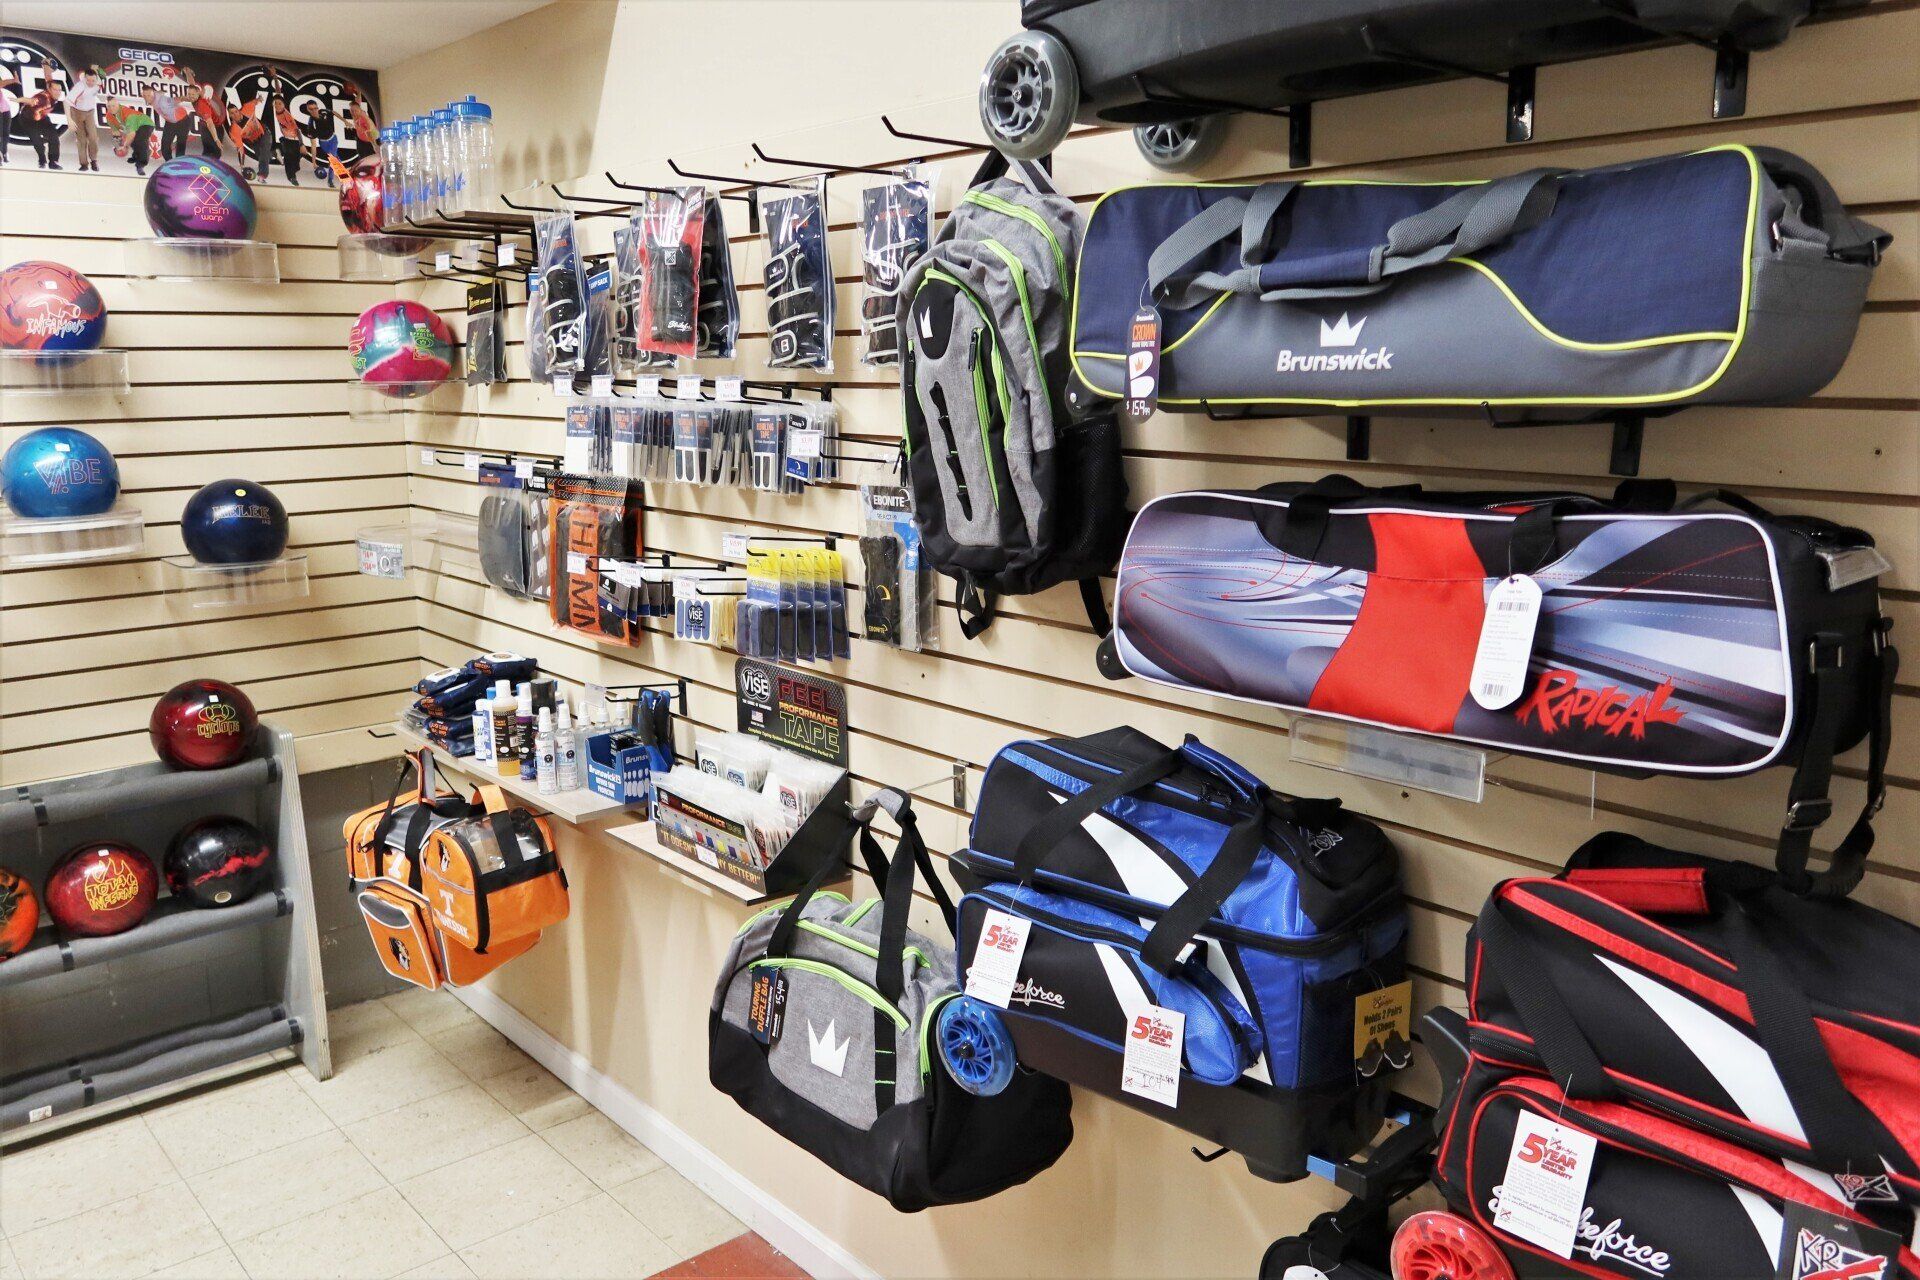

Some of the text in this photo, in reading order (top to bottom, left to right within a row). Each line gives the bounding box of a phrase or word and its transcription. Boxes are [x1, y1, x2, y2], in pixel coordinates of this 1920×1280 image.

[120, 49, 174, 64] GEICO
[121, 63, 162, 79] PBA
[194, 204, 229, 216] prism
[201, 214, 223, 222] warp
[26, 317, 86, 337] INFAMOUS
[1132, 323, 1157, 341] CROWN
[1276, 347, 1395, 372] Brunswick
[873, 494, 904, 508] EBONITE
[776, 675, 839, 716] FEEL
[1515, 669, 1687, 742] RADICAL
[778, 701, 838, 727] PROFORMANCE
[196, 719, 241, 739] cyclops
[780, 710, 839, 754] TAPE
[86, 873, 138, 899] TOTAL
[983, 925, 1002, 947] 5
[999, 933, 1018, 946] YEAR
[751, 982, 761, 1021] TOURING
[756, 976, 769, 1033] DUFFLE BAG
[1363, 1005, 1402, 1026] Holds 2 Pairs
[1131, 1015, 1151, 1040] 5
[1149, 1026, 1174, 1040] YEAR
[1377, 1020, 1396, 1033] Shoes
[1517, 1132, 1548, 1164] 5
[1544, 1143, 1577, 1170] YEAR
[1541, 1163, 1573, 1181] WARRANTY
[1542, 1159, 1566, 1172] LIMITED
